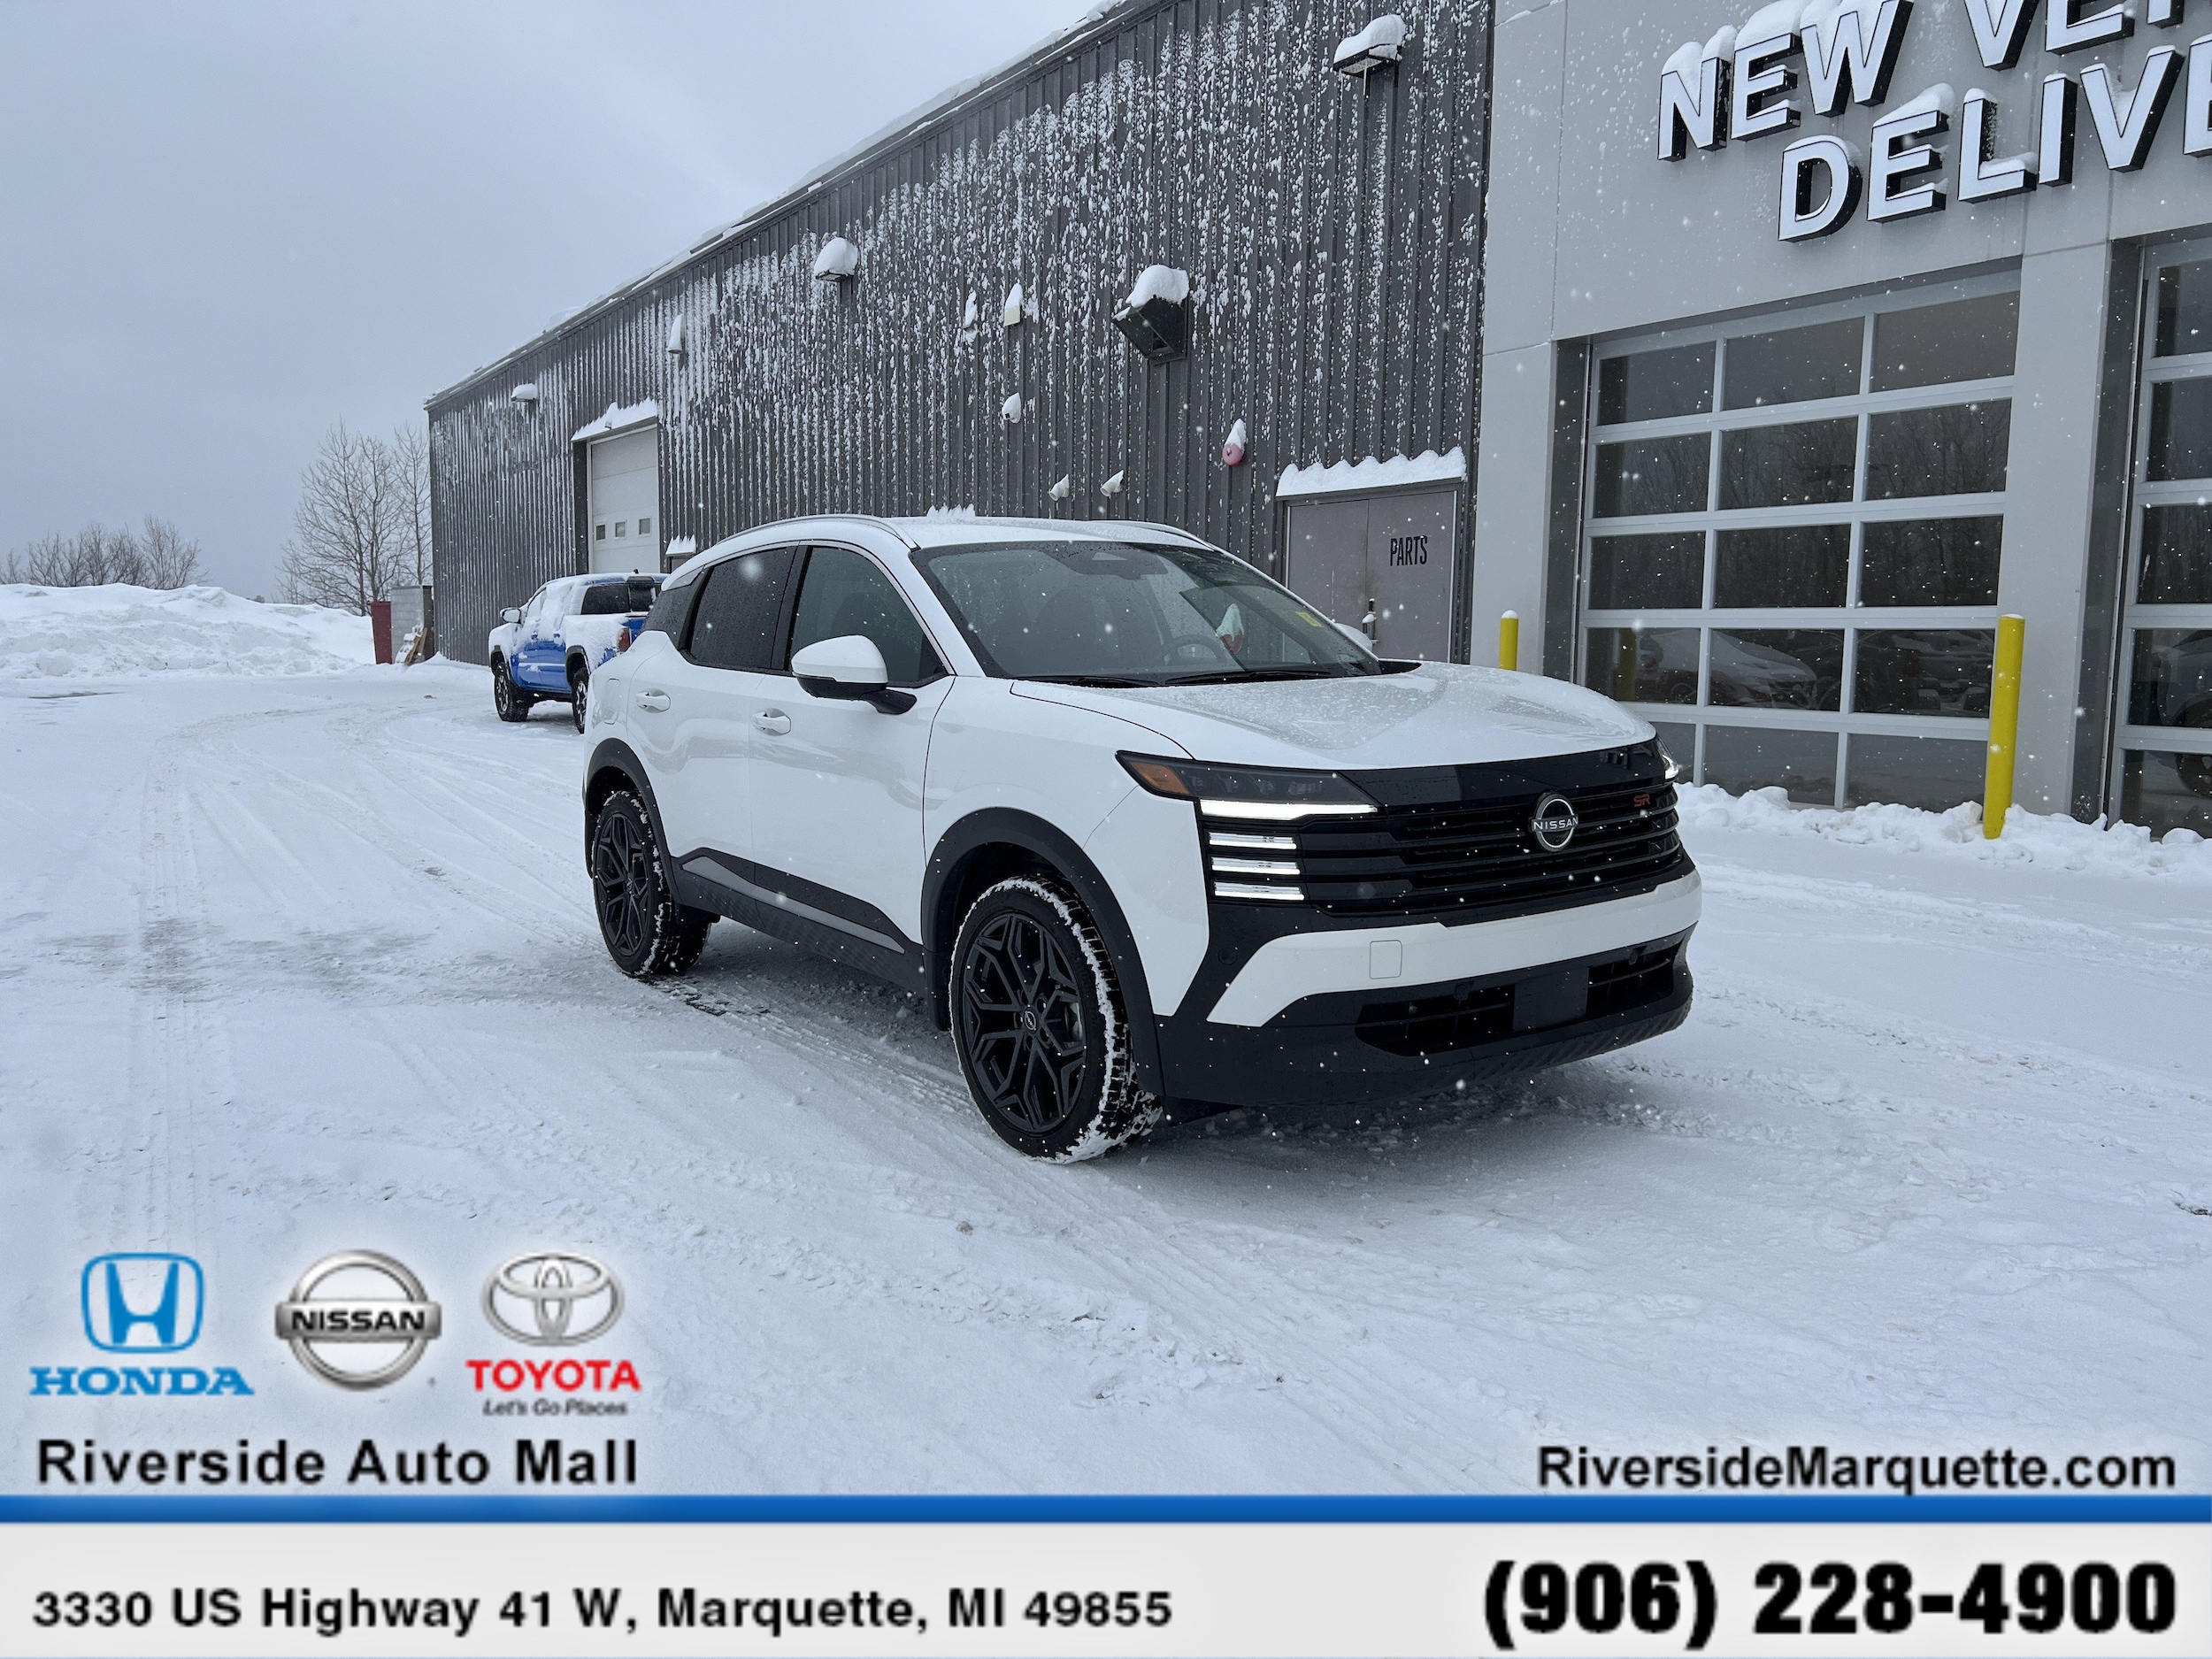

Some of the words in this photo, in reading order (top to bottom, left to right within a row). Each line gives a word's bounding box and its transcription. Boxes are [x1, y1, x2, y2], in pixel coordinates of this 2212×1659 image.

[1658, 0, 1913, 161] NEW
[1390, 535, 1427, 566] PARTS
[1633, 794, 1651, 807] SR
[1532, 816, 1578, 830] NISSAN
